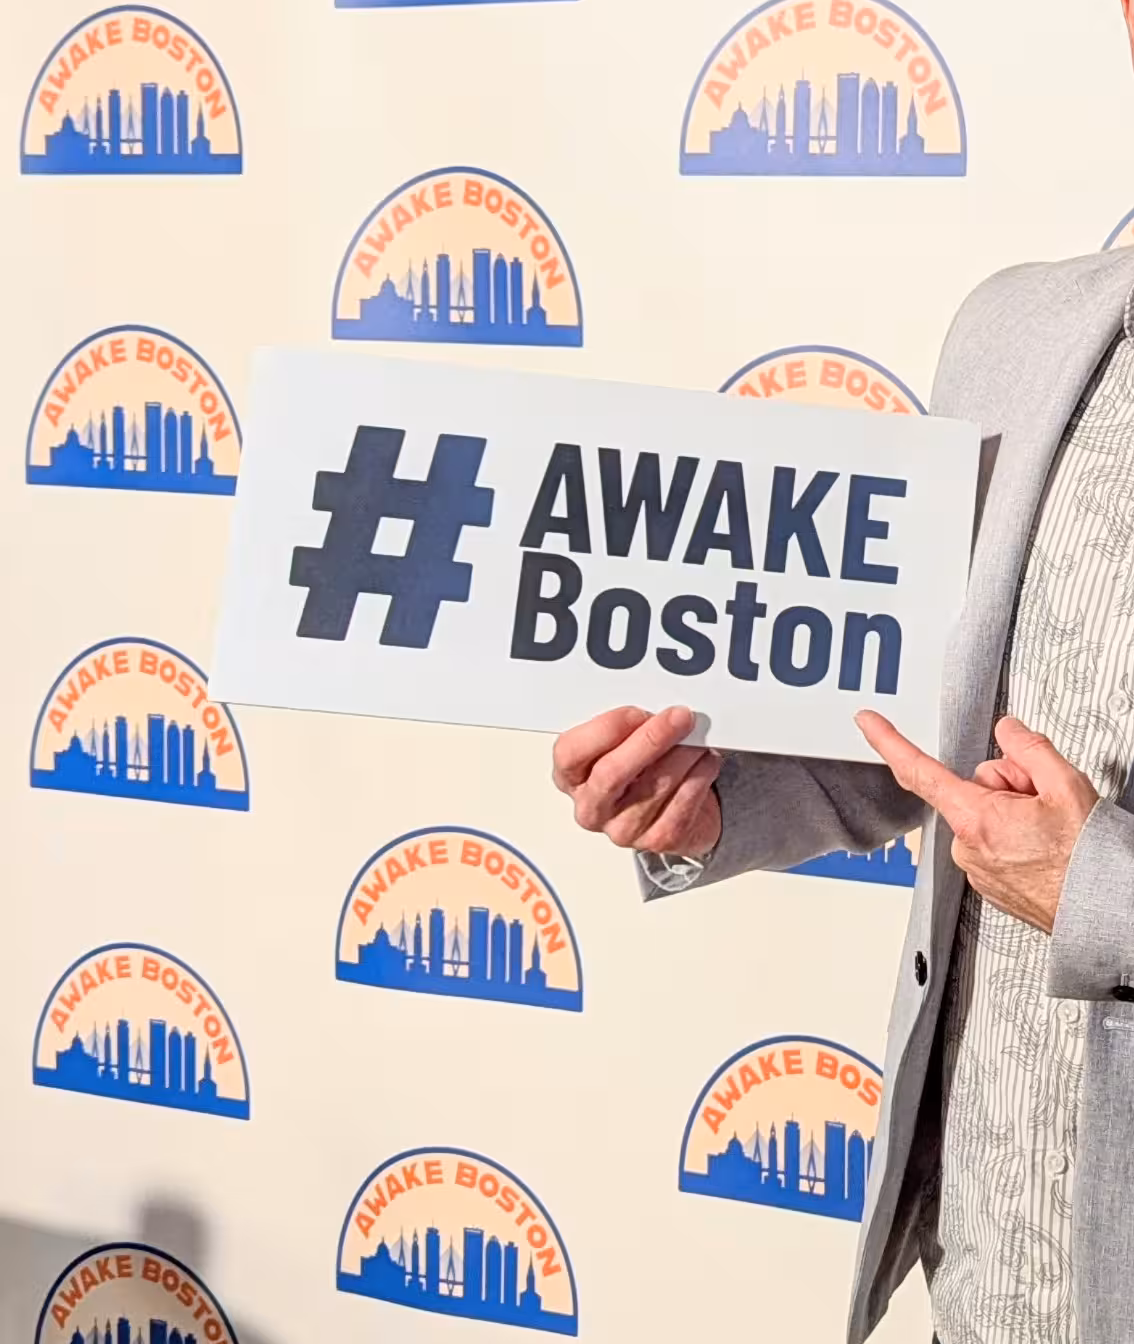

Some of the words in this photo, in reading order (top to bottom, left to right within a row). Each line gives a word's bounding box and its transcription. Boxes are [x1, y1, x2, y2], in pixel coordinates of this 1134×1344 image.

[39, 20, 123, 115] AWAKE
[131, 17, 227, 120] BOSTON
[705, 3, 815, 107] AWAKE
[830, 0, 946, 114] BOSTON
[355, 182, 453, 277] AWAKE
[463, 179, 565, 289] BOSTON
[45, 339, 127, 428] AWAKE
[136, 338, 232, 442] BOSTON
[519, 443, 907, 584] AWAKE
[510, 551, 902, 695] Boston
[48, 650, 130, 733] AWAKE
[139, 650, 234, 757] BOSTON
[352, 840, 449, 926] AWAKE
[460, 840, 566, 954] BOSTON
[51, 955, 132, 1033] AWAKE
[141, 957, 234, 1065] BOSTON
[702, 1049, 804, 1135] AWAKE
[815, 1050, 882, 1107] BOS
[354, 1160, 444, 1240] AWAKE
[455, 1161, 562, 1278] BOSTON
[51, 1253, 134, 1329] AWAKE
